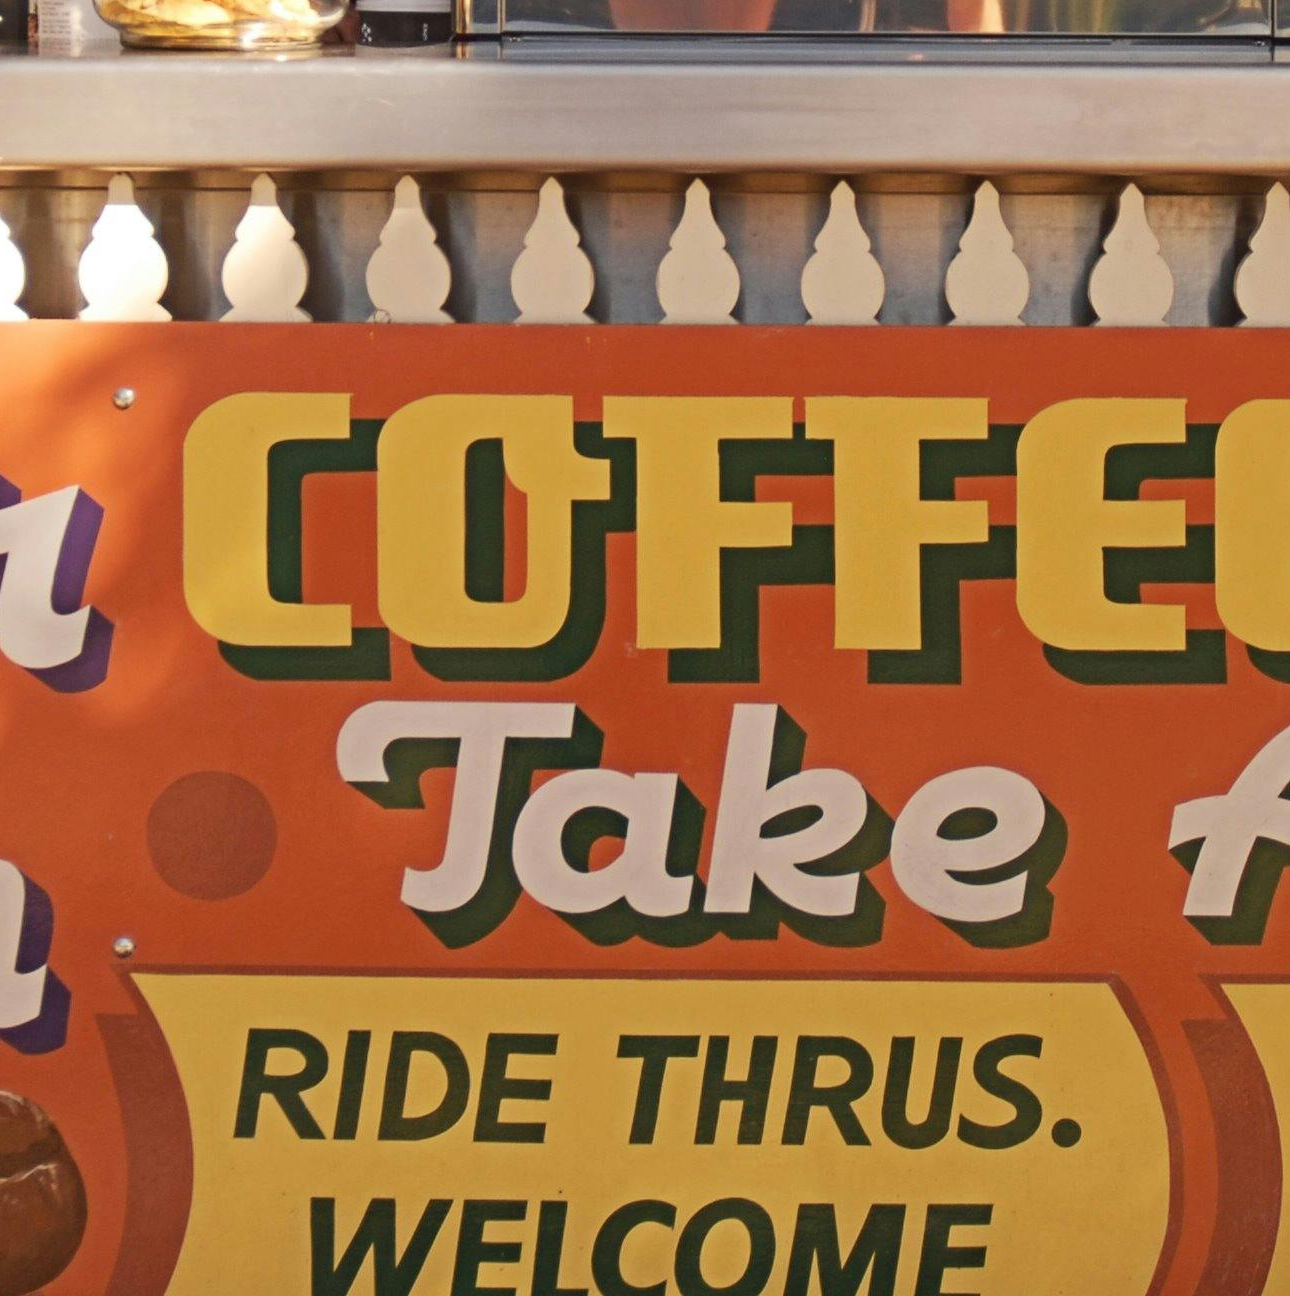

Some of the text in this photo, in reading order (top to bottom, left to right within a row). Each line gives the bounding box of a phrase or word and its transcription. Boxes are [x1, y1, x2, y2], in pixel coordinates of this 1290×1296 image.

[335, 699, 1047, 923] Take
[232, 1027, 1083, 1151] RIDE THRUS.
[309, 1196, 995, 1296] WELCOME
